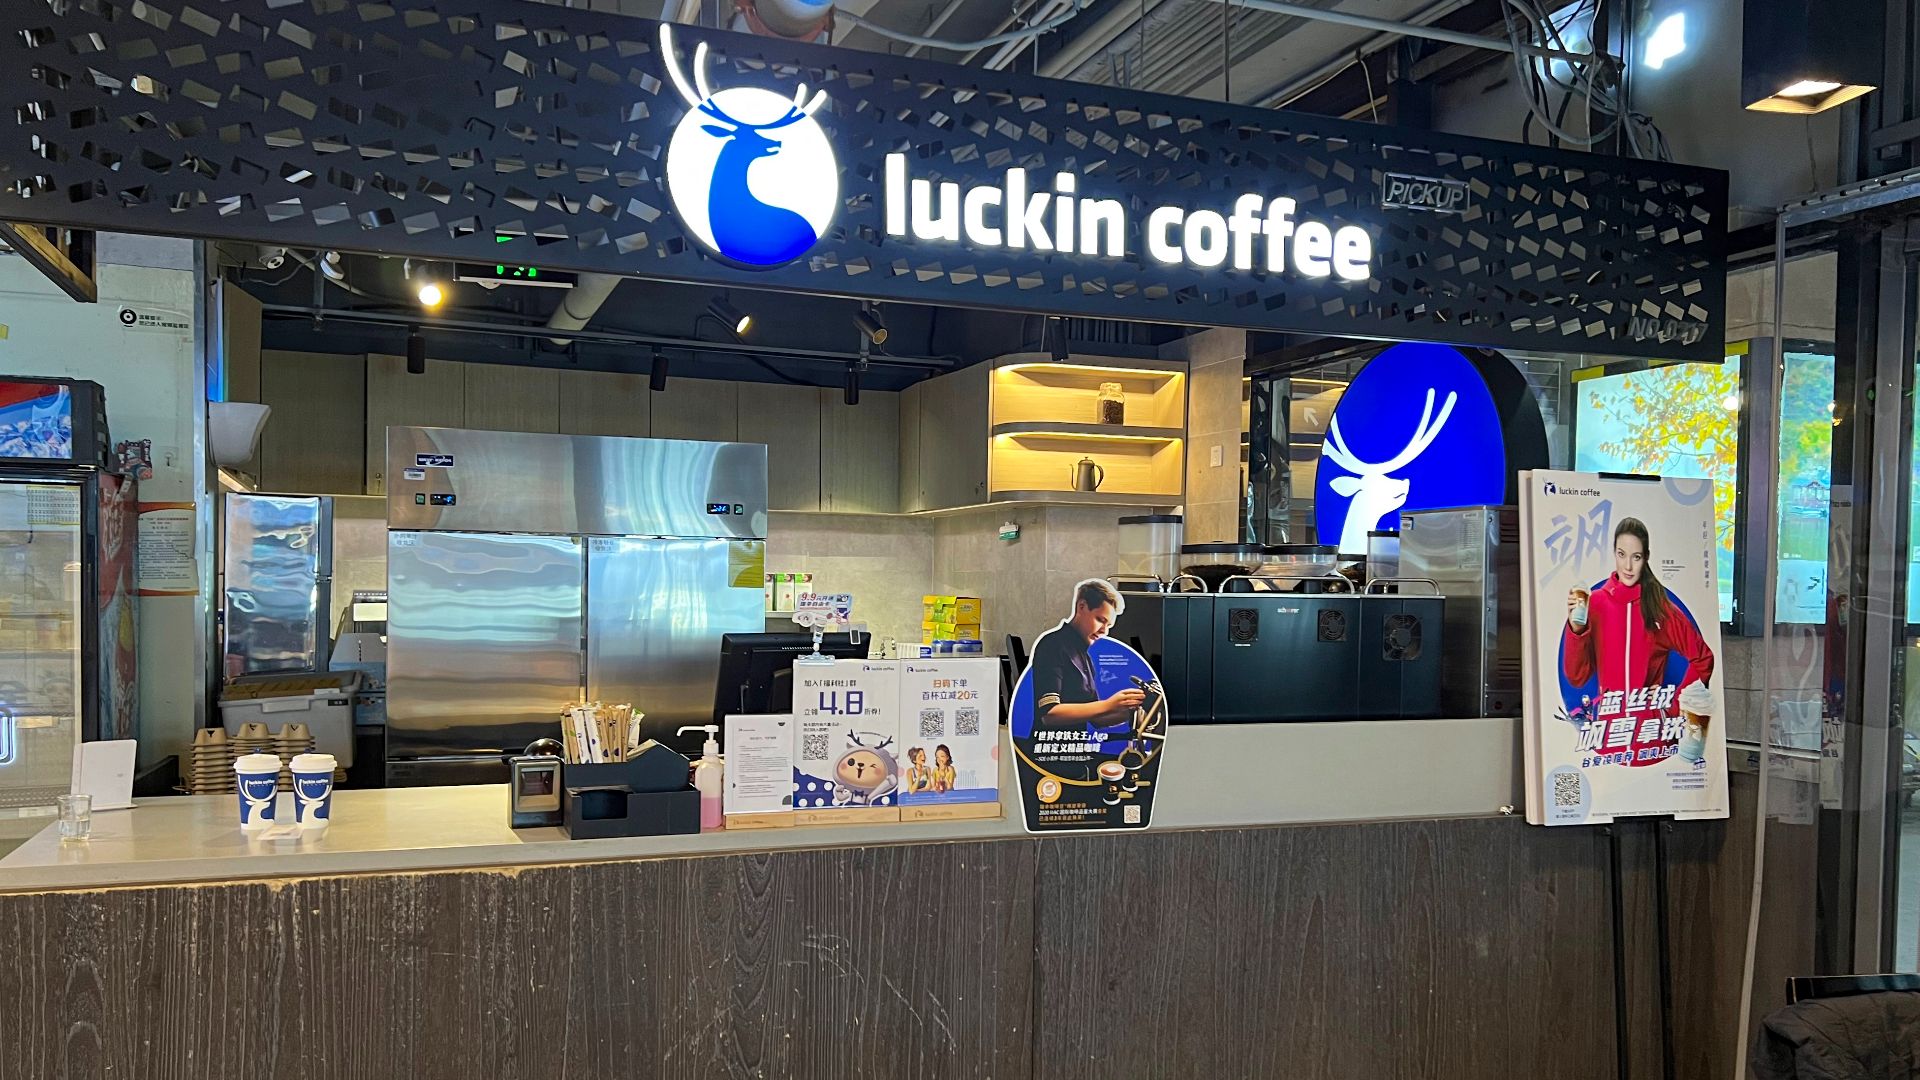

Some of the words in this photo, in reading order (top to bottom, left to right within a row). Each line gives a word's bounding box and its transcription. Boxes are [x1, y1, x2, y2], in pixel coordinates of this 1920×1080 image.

[1386, 181, 1464, 208] PICKUP
[885, 153, 1125, 257] luckin
[1147, 194, 1371, 280] coffee
[1559, 487, 1579, 496] luckin
[1580, 488, 1601, 497] coffee
[922, 690, 979, 700] 首杯立减20元
[1599, 684, 1676, 716] 蓝丝绒
[1575, 716, 1686, 752] 飒雪拿铁
